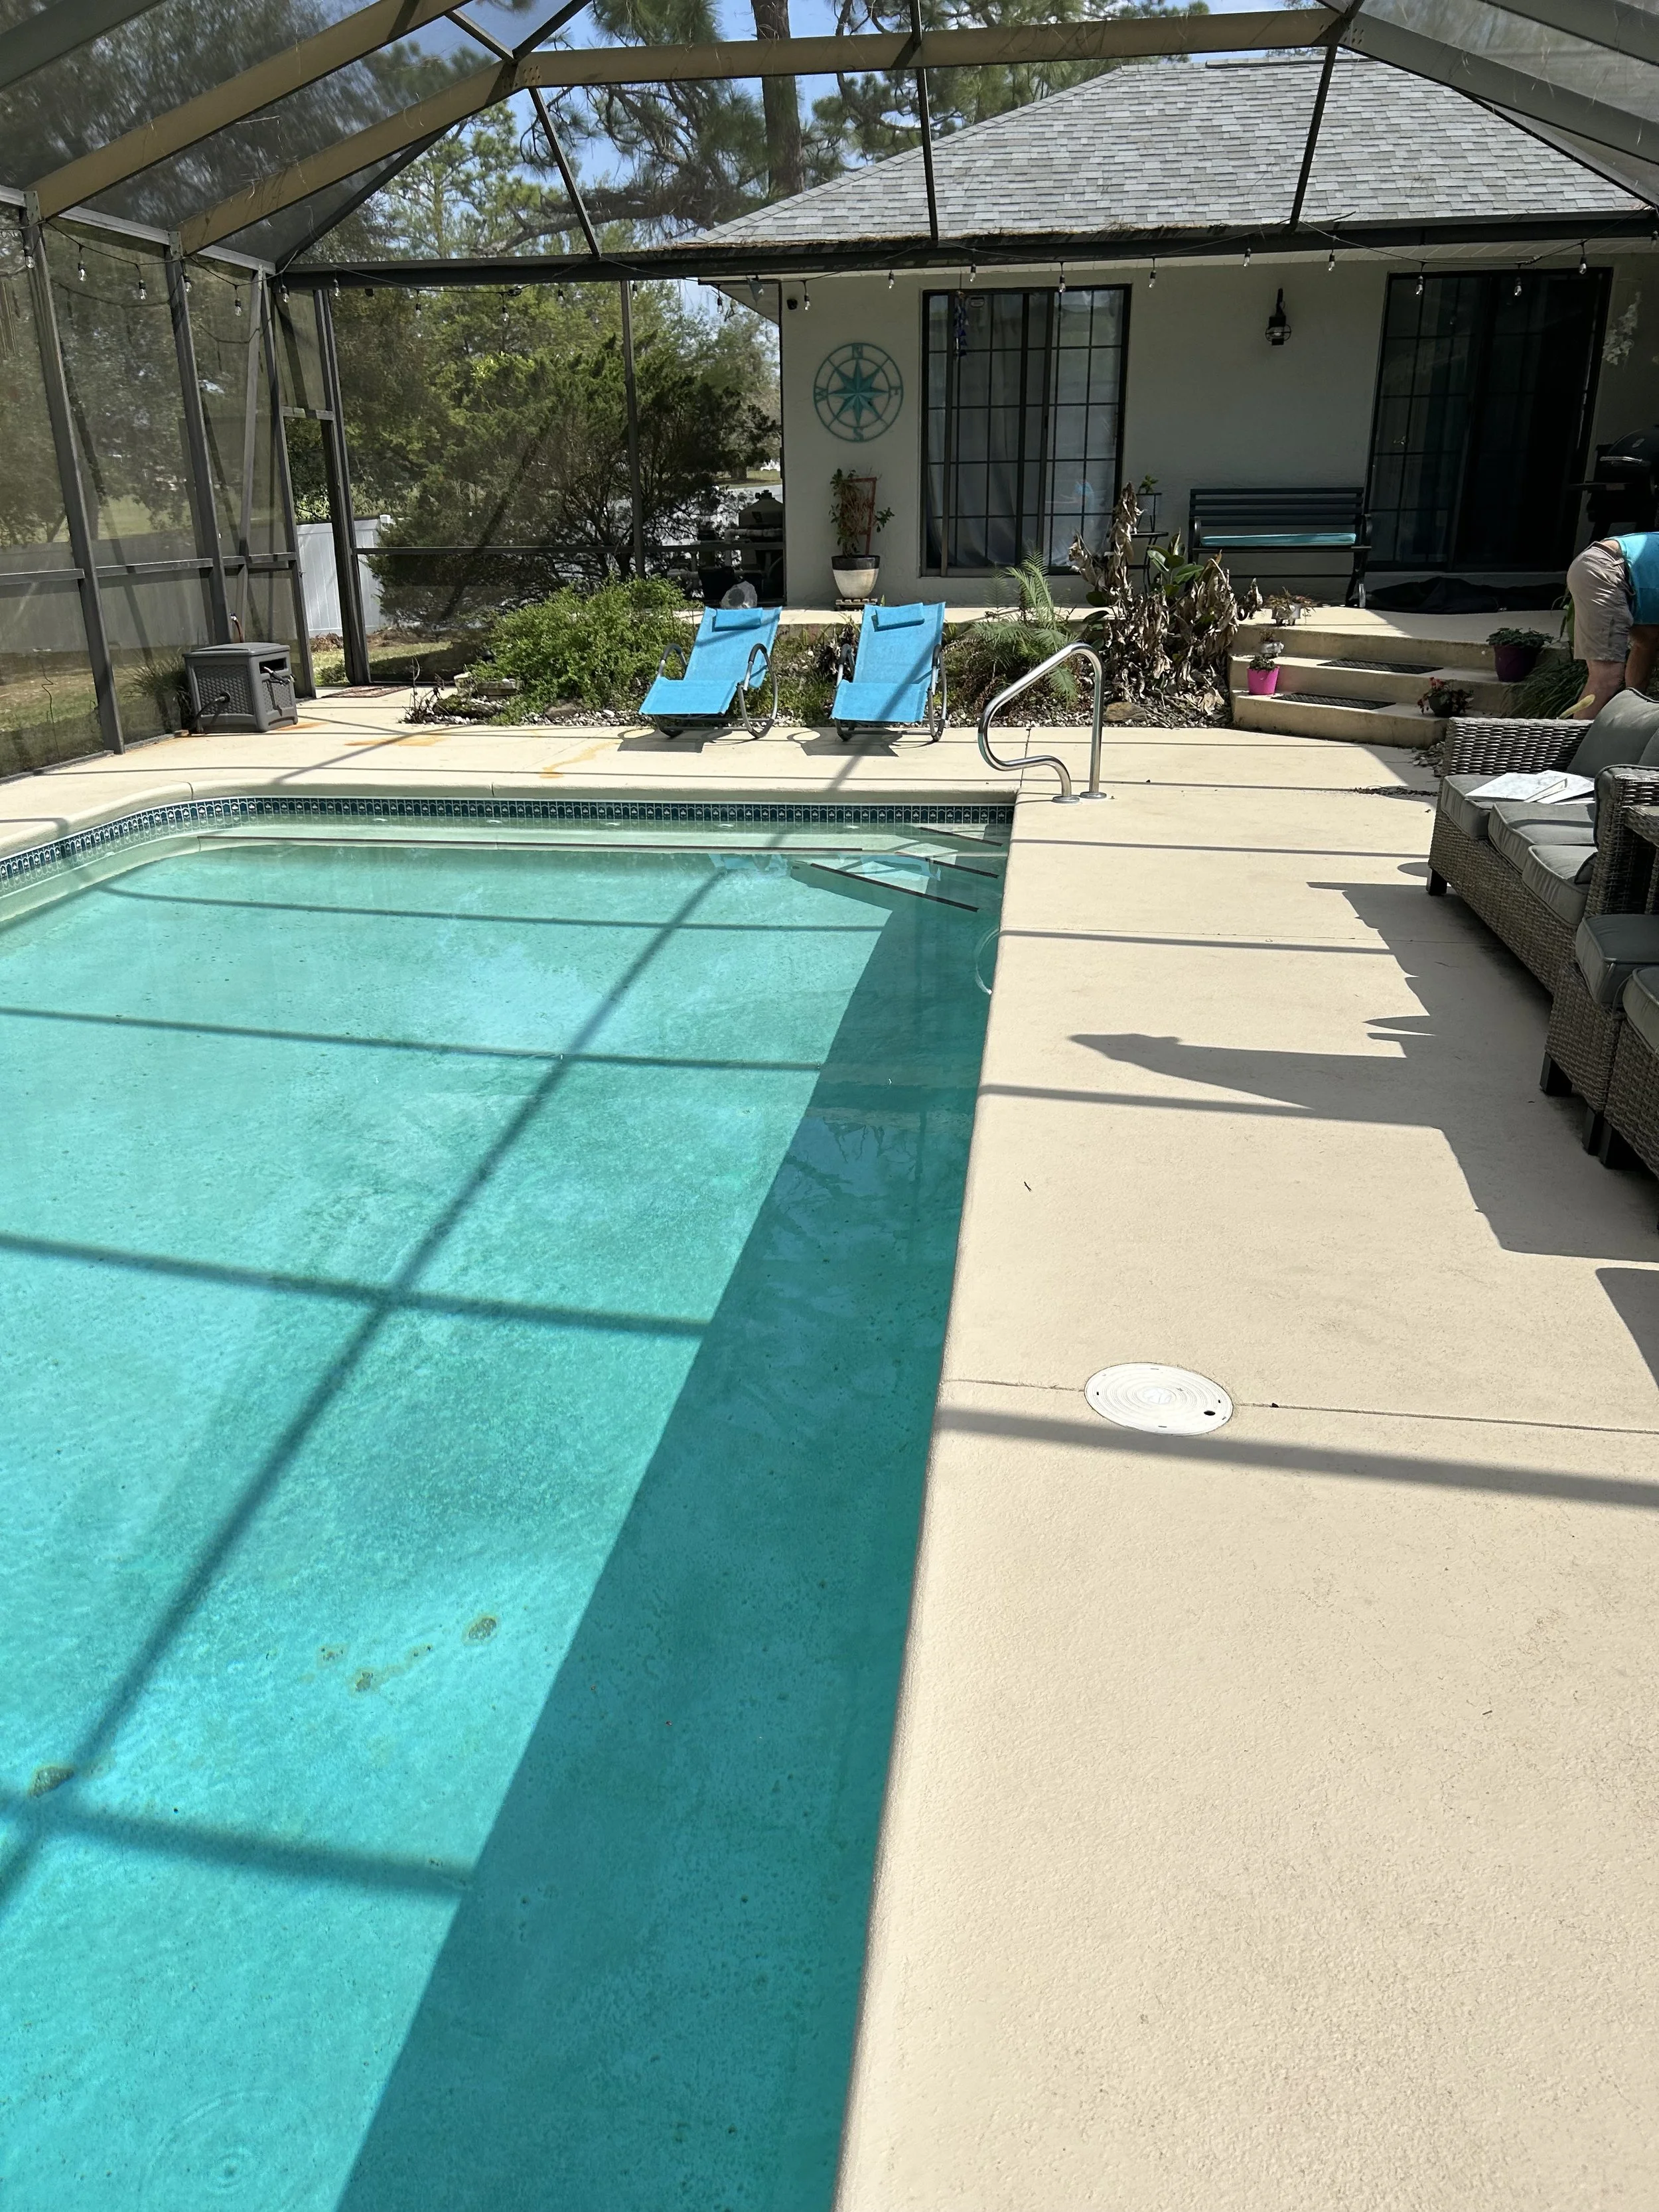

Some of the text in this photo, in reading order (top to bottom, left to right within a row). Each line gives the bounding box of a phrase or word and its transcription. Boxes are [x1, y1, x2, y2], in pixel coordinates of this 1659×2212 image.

[852, 344, 863, 359] N
[814, 385, 827, 403] W
[889, 386, 902, 400] E
[853, 426, 863, 441] S
